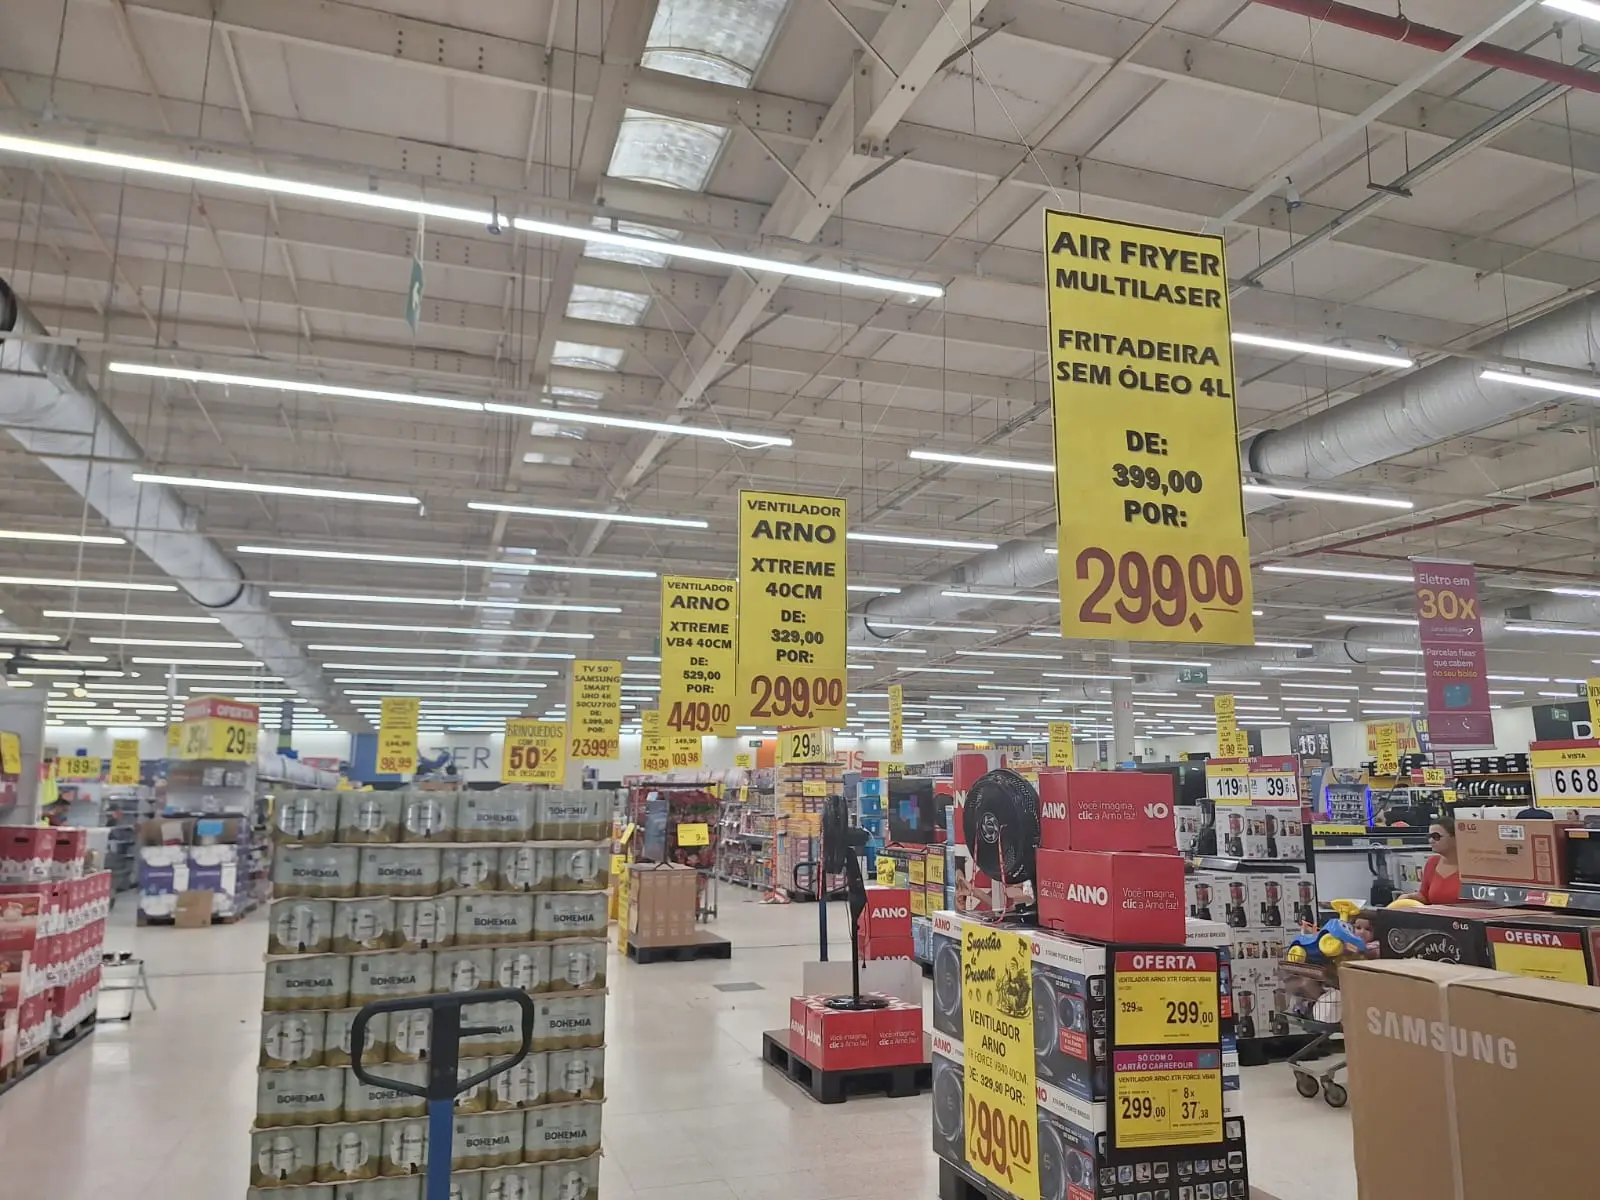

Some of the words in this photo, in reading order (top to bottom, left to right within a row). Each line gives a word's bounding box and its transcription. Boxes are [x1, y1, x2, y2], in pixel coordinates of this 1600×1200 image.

[1051, 230, 1111, 262] AIR
[1120, 240, 1221, 278] FRYER
[1055, 267, 1222, 308] MULTILASER
[1058, 329, 1220, 367] FRITADEIRA
[1056, 361, 1111, 387] SEM
[1118, 363, 1192, 395] ÓLEO
[1200, 377, 1232, 398] 4L
[1125, 429, 1169, 456] DE:
[1112, 463, 1203, 497] 399,00
[747, 499, 841, 517] VENTILADOR
[1124, 499, 1188, 528] POR:
[751, 519, 837, 544] ARNO
[750, 557, 836, 577] XTREME
[667, 581, 733, 593] VENTILADOR
[1418, 573, 1452, 586] Eletro
[1453, 577, 1470, 586] em
[765, 582, 823, 600] 40CM
[670, 594, 730, 611] ARNO
[1417, 589, 1477, 620] 30x
[781, 609, 806, 624] DE:
[669, 620, 729, 634] XTREME
[666, 636, 693, 648] VB4
[696, 637, 732, 649] 40CM
[770, 628, 824, 645] 329,00
[776, 648, 814, 663] POR:
[1426, 648, 1458, 657] Parcelas
[1459, 648, 1476, 657] fixas
[582, 665, 595, 673] TV
[690, 656, 709, 667] DE:
[1449, 659, 1473, 668] cabem
[575, 674, 620, 684] SAMSUNG
[686, 683, 714, 694] POR:
[792, 733, 810, 758] 29
[1216, 778, 1239, 796] 119
[1267, 777, 1284, 796] 39
[1041, 801, 1066, 820] ARNO
[1078, 801, 1097, 810] Você
[476, 812, 519, 823] BOHEMIA
[1078, 811, 1093, 820] clic
[1467, 823, 1477, 831] LG
[292, 867, 340, 879] BOHEMIA
[377, 866, 423, 877] BOHEMIA
[1067, 883, 1108, 906] ARNO
[1122, 887, 1141, 897] Você
[1122, 900, 1137, 909] clic
[553, 913, 595, 924] BOHEMIA
[871, 907, 908, 919] ARNO
[474, 917, 517, 927] BOHEMIA
[934, 917, 950, 932] ARNO
[967, 932, 1002, 957] Sugestão
[1504, 930, 1562, 946] OFERTA
[1133, 954, 1197, 969] OFERTA
[285, 977, 334, 989] BOHEMIA
[369, 975, 416, 986] BOHEMIA
[965, 966, 996, 985] Presente
[549, 1018, 592, 1029] BOHEMIA
[790, 1018, 805, 1036] ARNO
[969, 1008, 1021, 1043] VENTILADOR
[806, 1029, 821, 1047] ARNO
[1366, 1006, 1518, 1069] SAMSUNG
[932, 1037, 952, 1054] ARNO
[981, 1034, 1006, 1057] ARNO
[1137, 1053, 1148, 1062] SÓ
[1150, 1053, 1167, 1061] COM
[1167, 1053, 1173, 1061] O
[1117, 1061, 1149, 1071] CARTÃO
[1149, 1061, 1194, 1070] CARREFOUR
[277, 1093, 325, 1105] BOHEMIA
[1004, 1084, 1026, 1107] POR:
[466, 1135, 510, 1147] BOHEMIA
[544, 1129, 587, 1141] BOHEMIA
